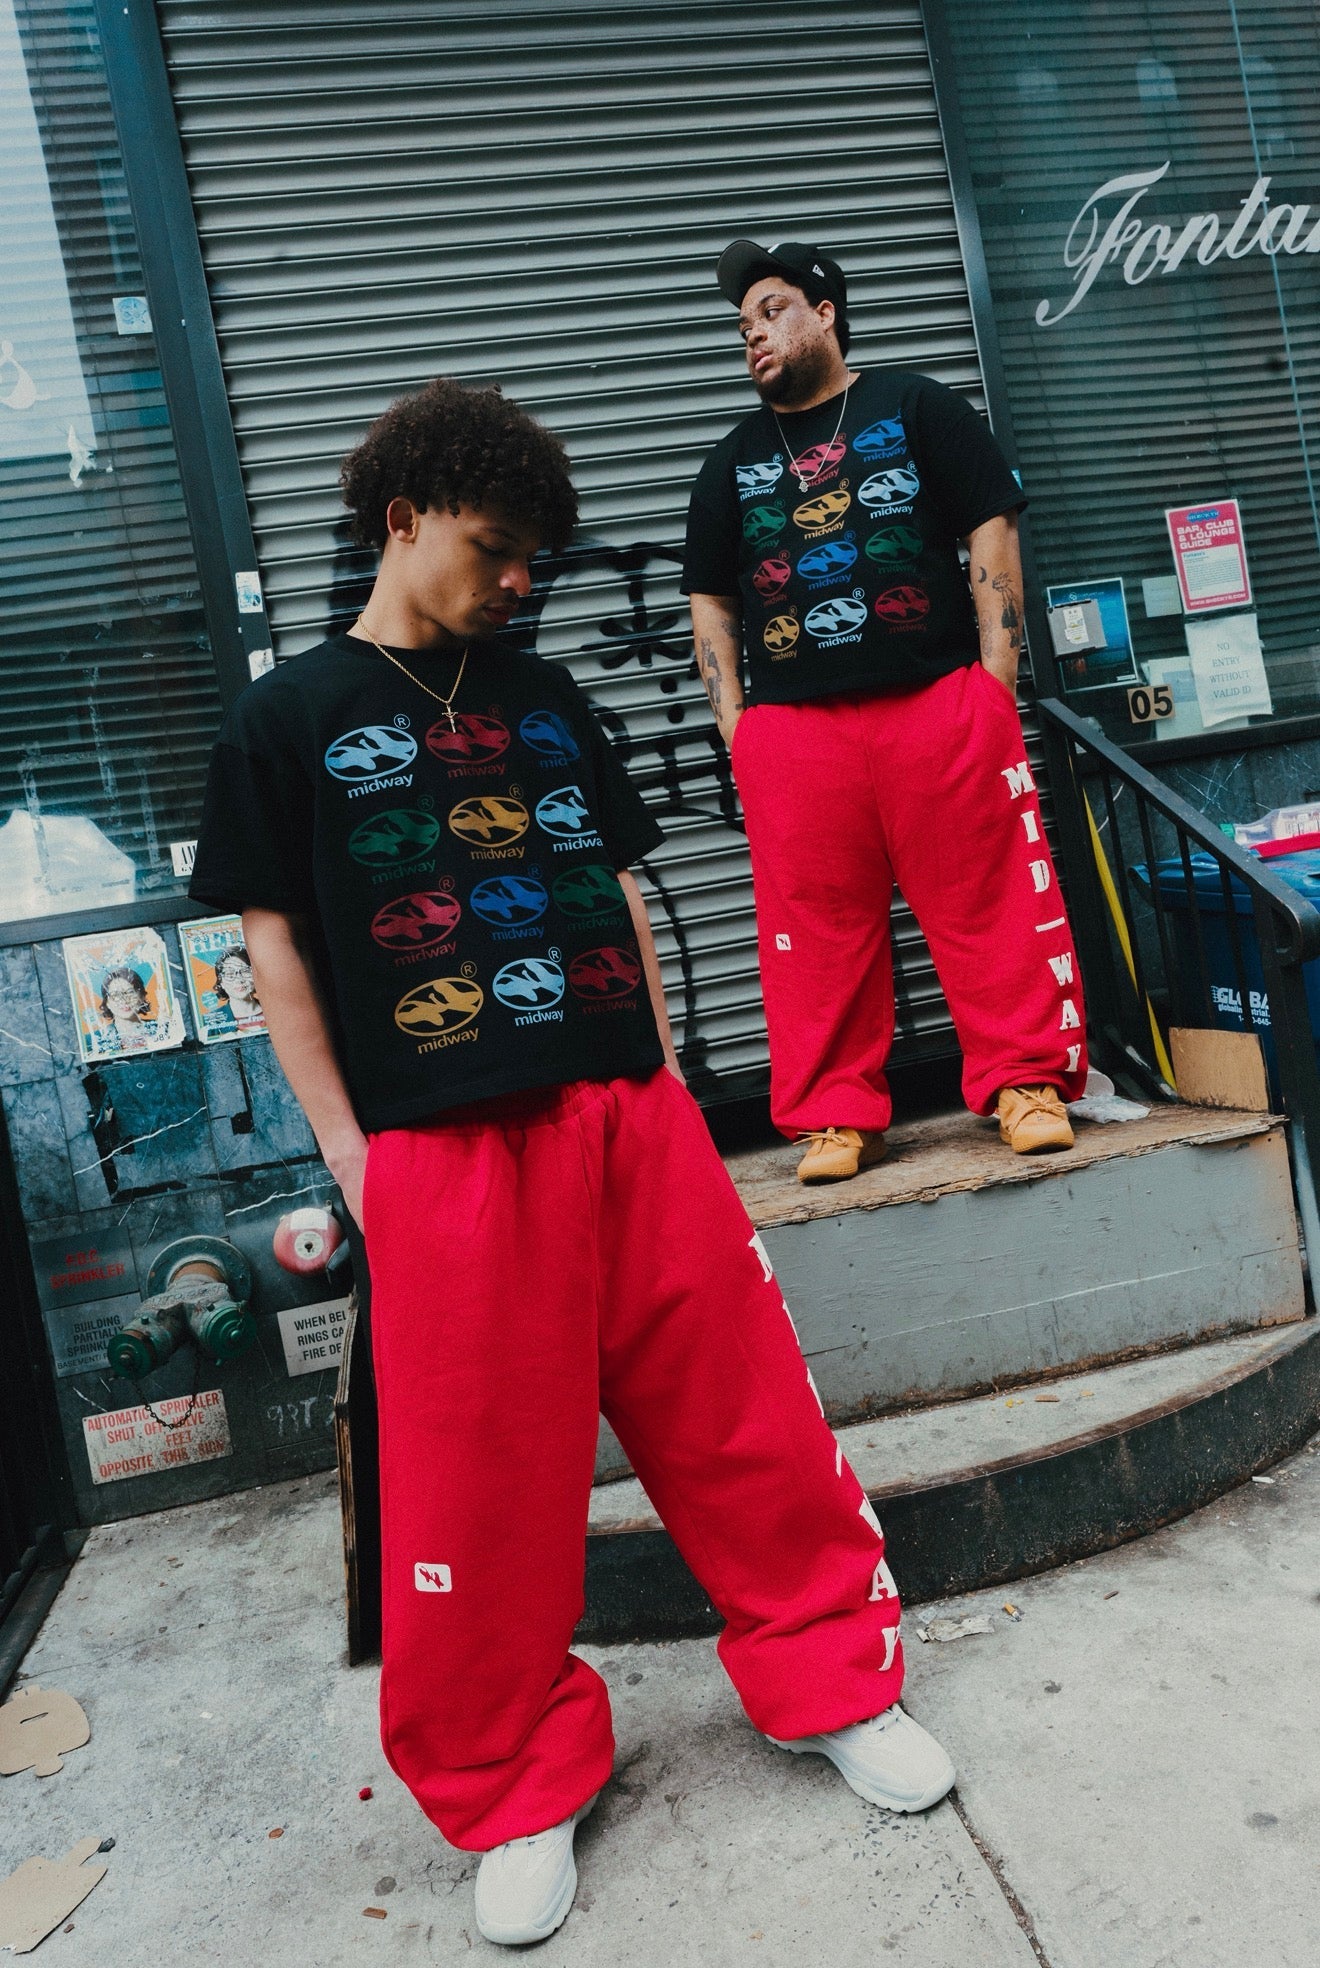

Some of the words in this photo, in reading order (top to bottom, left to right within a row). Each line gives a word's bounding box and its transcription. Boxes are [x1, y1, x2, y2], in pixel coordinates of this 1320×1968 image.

[1035, 160, 1320, 327] Fonta
[863, 446, 907, 462] midway
[869, 505, 913, 519] midway
[804, 520, 844, 540] midway
[1177, 525, 1203, 535] BAR,
[1206, 519, 1234, 530] CLUB
[1190, 527, 1236, 540] LOUNGE
[1180, 539, 1212, 549] GUIDE
[808, 573, 852, 591] midway
[818, 633, 863, 649] midway
[1217, 642, 1230, 651] NO
[1212, 656, 1241, 667] ENTRY
[1209, 670, 1249, 683] WITHOUT
[1213, 687, 1239, 698] VALID
[1242, 685, 1251, 694] ID
[1131, 686, 1172, 720] 05
[447, 763, 506, 778] midway
[348, 774, 413, 799] midway
[470, 846, 525, 860] midway
[372, 859, 436, 884] midway
[568, 915, 625, 931] midway
[492, 926, 545, 941] midway
[394, 941, 456, 968] midway
[583, 1001, 637, 1015] midway
[515, 1009, 564, 1027] midway
[418, 1028, 479, 1054] midway
[50, 1263, 125, 1289] SPRINKLER
[74, 1315, 121, 1333] BUILDING
[294, 1314, 326, 1331] WHEN
[297, 1330, 328, 1346] RINGS
[303, 1347, 326, 1361] FIRE
[88, 1409, 150, 1432] AUTOMATIC
[160, 1392, 219, 1416] SPRINKLER
[107, 1426, 136, 1444] SHUT
[144, 1421, 163, 1436] OFF
[165, 1430, 192, 1447] FEET
[100, 1454, 153, 1478] OPPOSITE
[161, 1447, 190, 1464] THIS
[197, 1439, 226, 1456] SIGN
